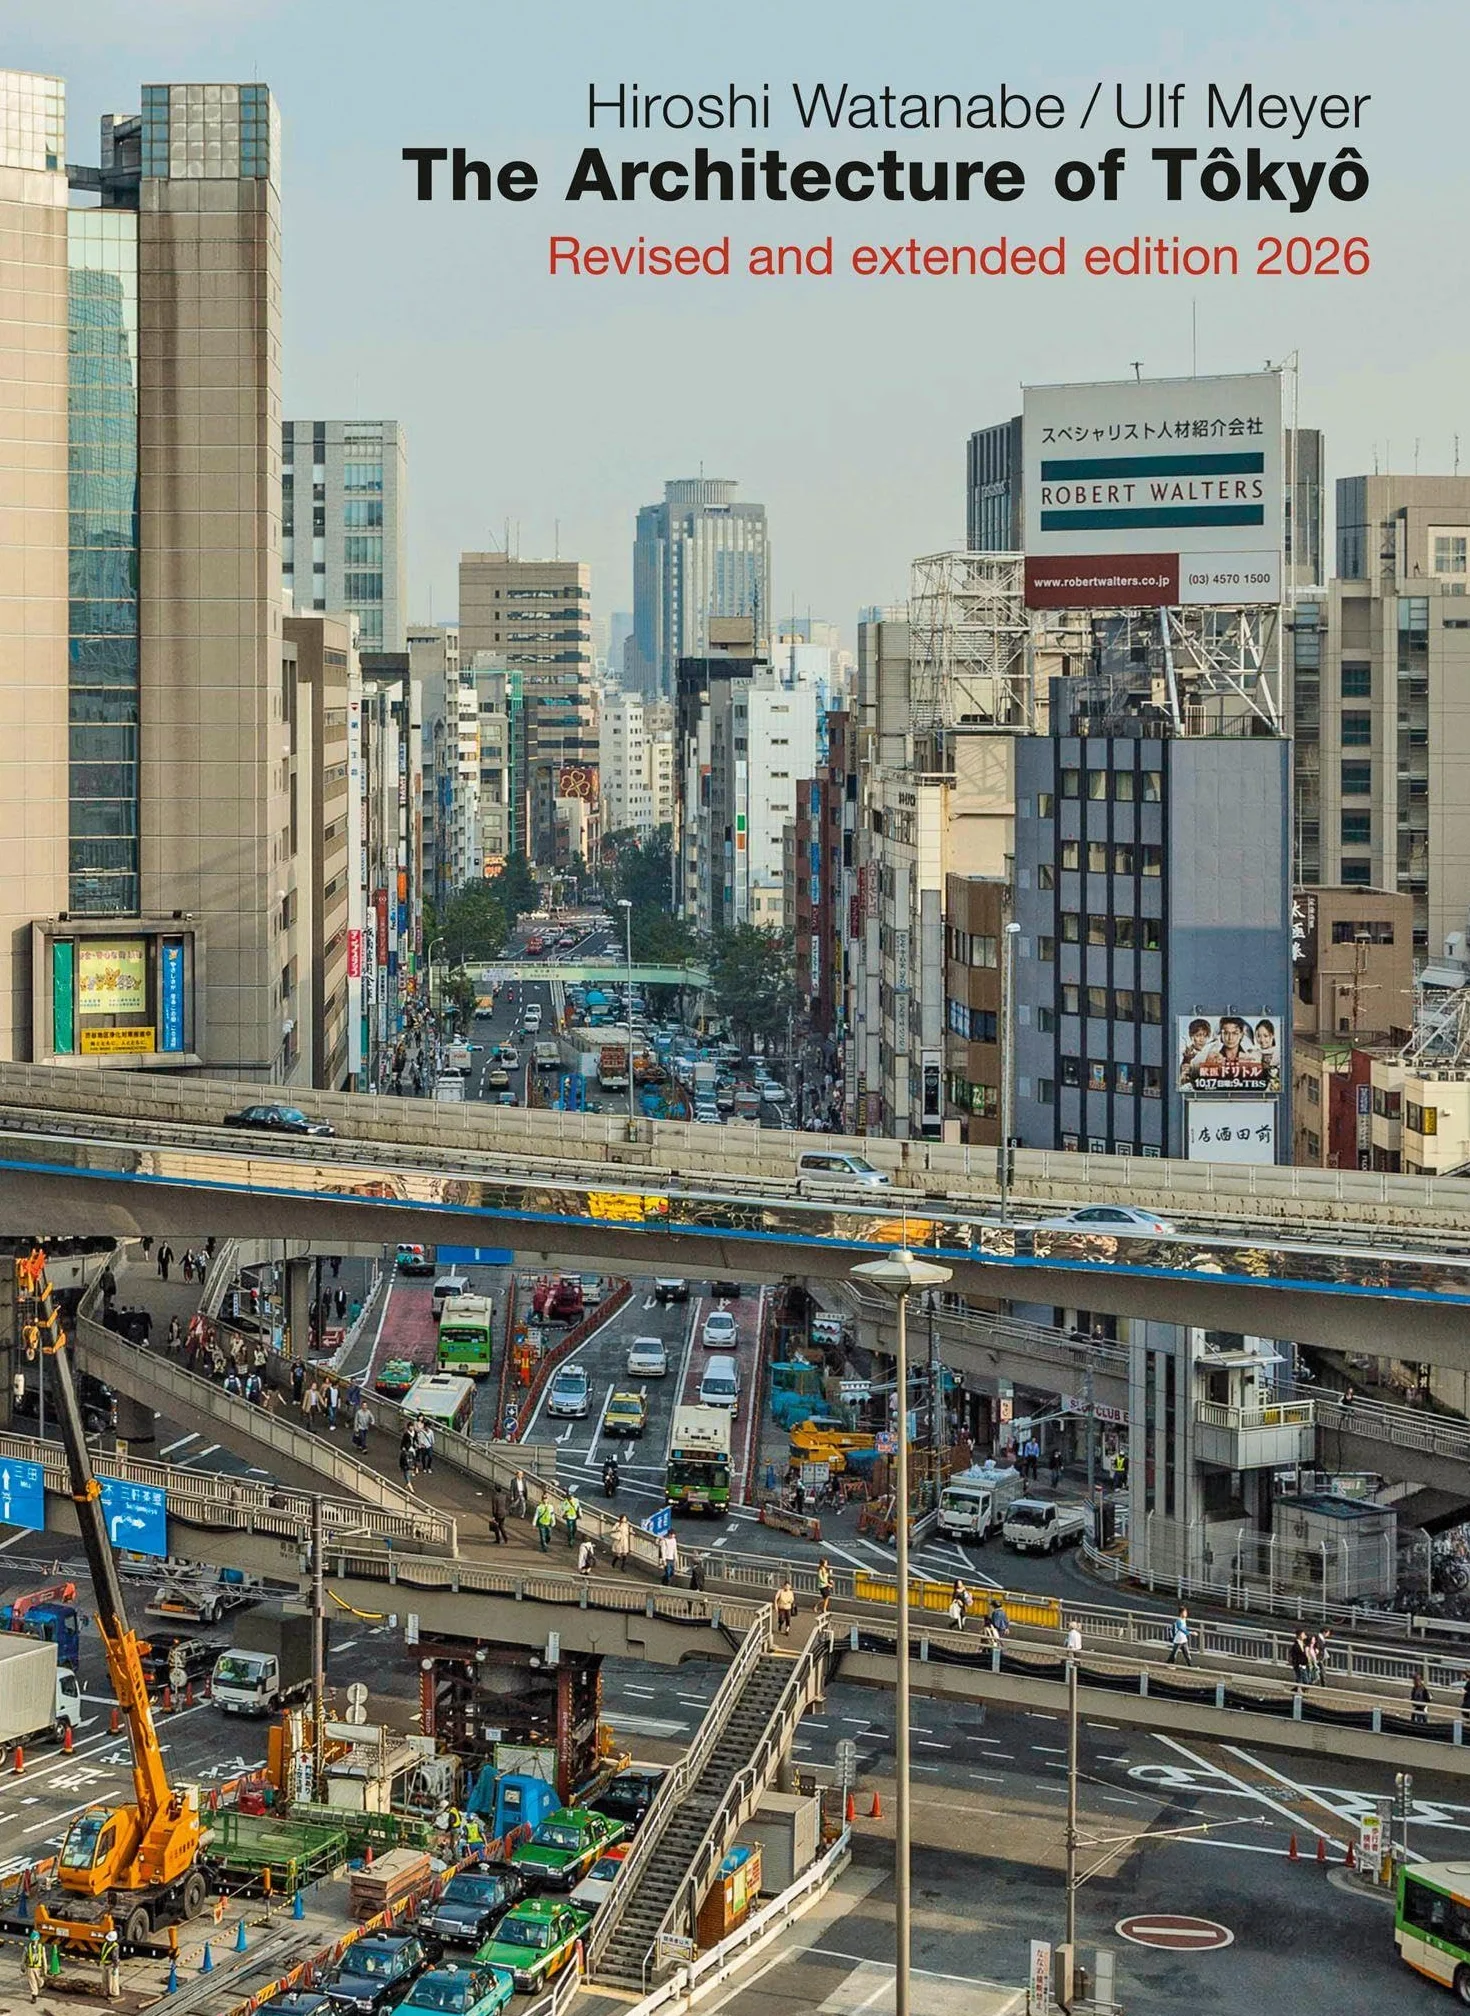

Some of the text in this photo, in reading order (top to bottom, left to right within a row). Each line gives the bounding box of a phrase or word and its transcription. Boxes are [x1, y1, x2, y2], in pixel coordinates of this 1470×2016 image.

[1042, 416, 1264, 444] スペシャリスト人材紹介会社
[1041, 479, 1264, 505] ROBERT WALTERS
[1034, 575, 1170, 588] www.robertwalters.co.jp
[1188, 573, 1271, 585] (03) 4570 1500
[1243, 1079, 1267, 1088] TBS
[1095, 1407, 1121, 1420] CLUB
